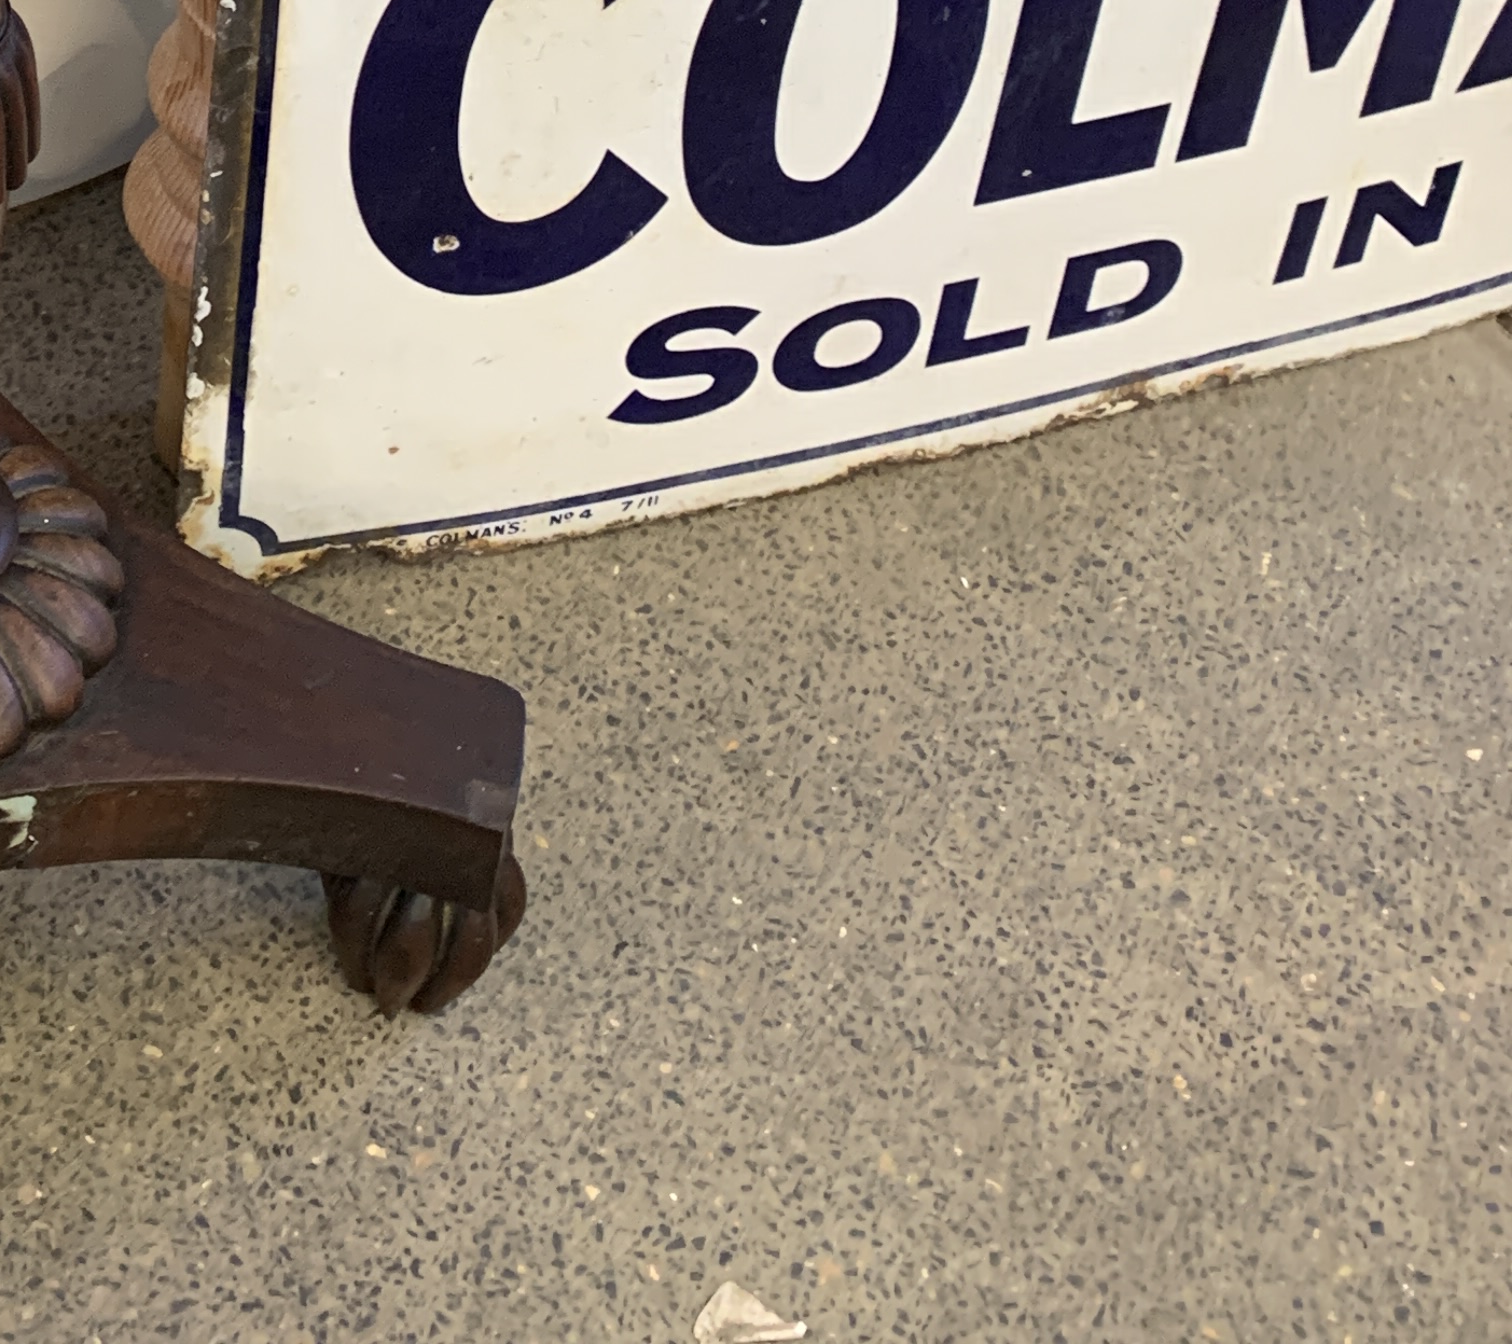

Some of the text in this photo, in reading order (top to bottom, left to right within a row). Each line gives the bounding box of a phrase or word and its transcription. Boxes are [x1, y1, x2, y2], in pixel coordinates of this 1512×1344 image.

[607, 159, 1464, 425] SOLD IN
[578, 508, 593, 519] 4
